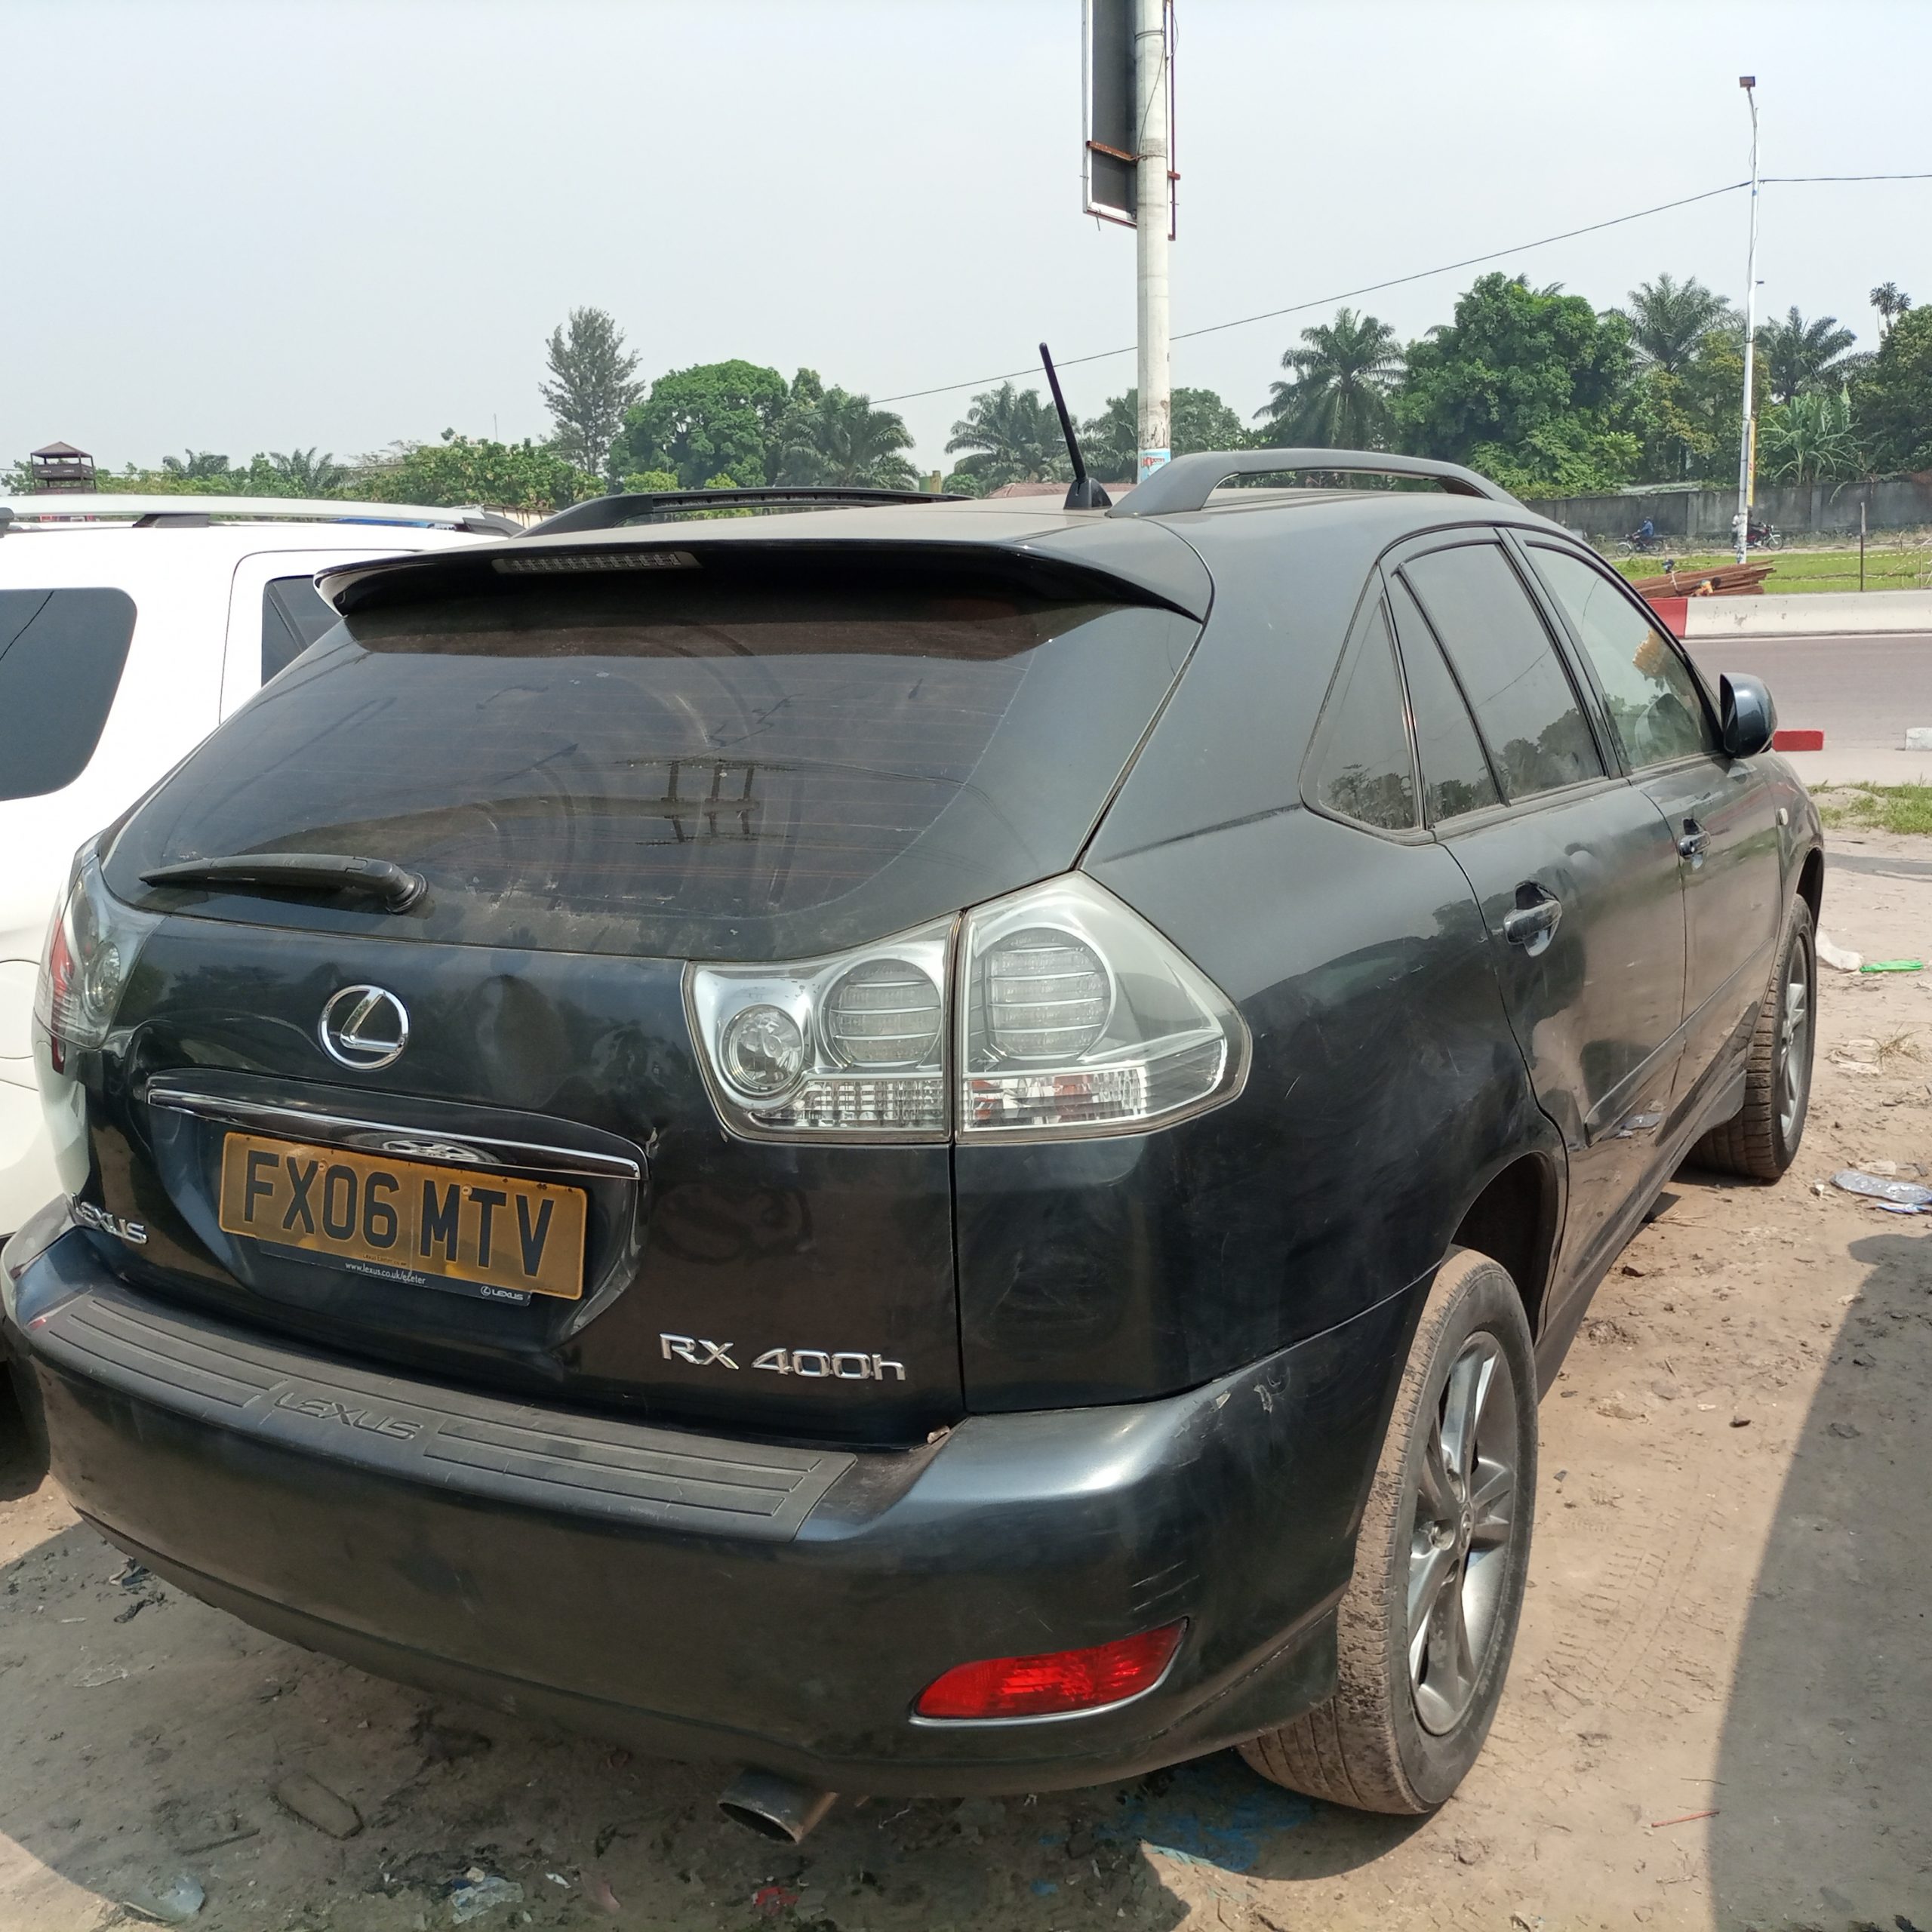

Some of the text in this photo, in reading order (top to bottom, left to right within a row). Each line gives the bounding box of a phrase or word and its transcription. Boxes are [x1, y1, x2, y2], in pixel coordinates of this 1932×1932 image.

[72, 1192, 148, 1244] LEXUS
[244, 1149, 555, 1277] FX06 MTV
[491, 1288, 524, 1301] LEXUS
[659, 1333, 906, 1381] RX 400h
[275, 1392, 424, 1440] LEXUS
